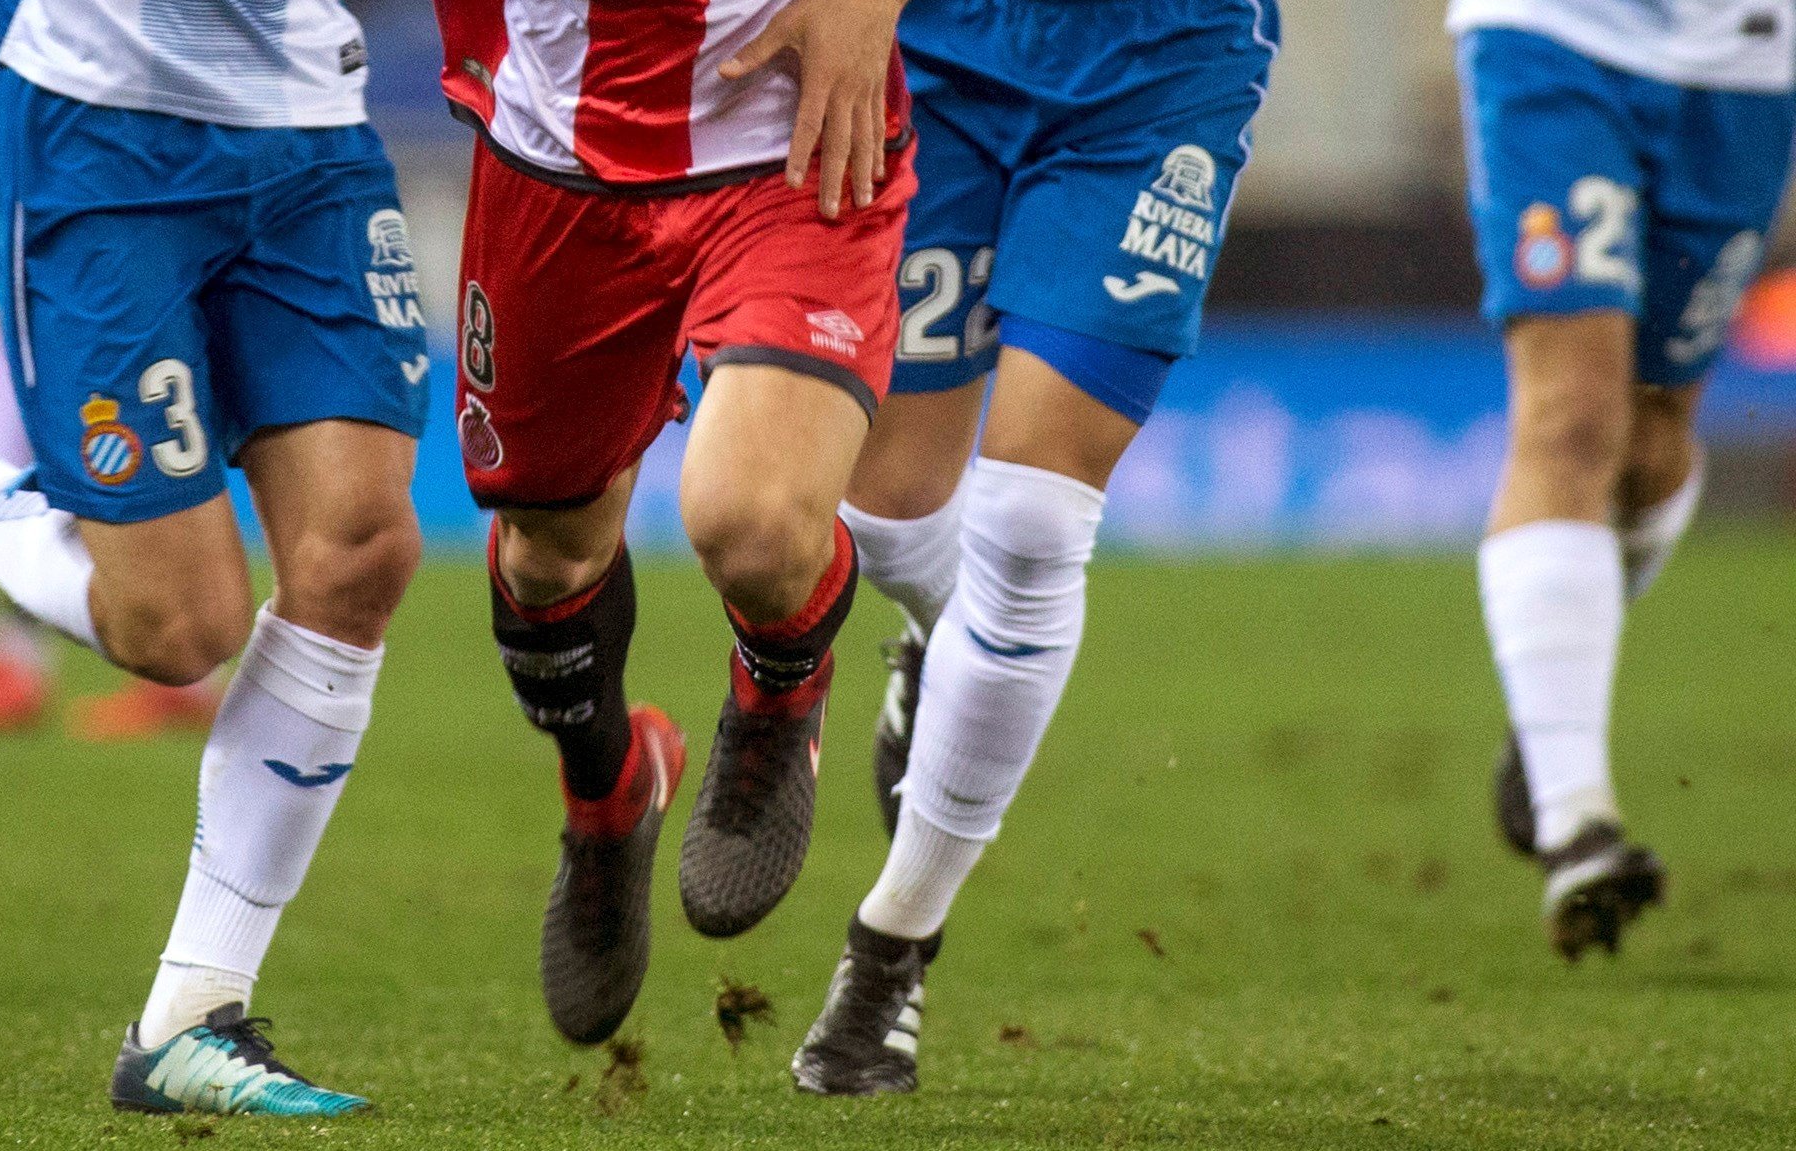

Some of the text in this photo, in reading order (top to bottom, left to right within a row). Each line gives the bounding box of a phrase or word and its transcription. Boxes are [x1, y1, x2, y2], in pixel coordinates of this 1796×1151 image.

[1119, 216, 1207, 280] MAYA
[462, 280, 495, 393] 8
[139, 359, 208, 478] 3
